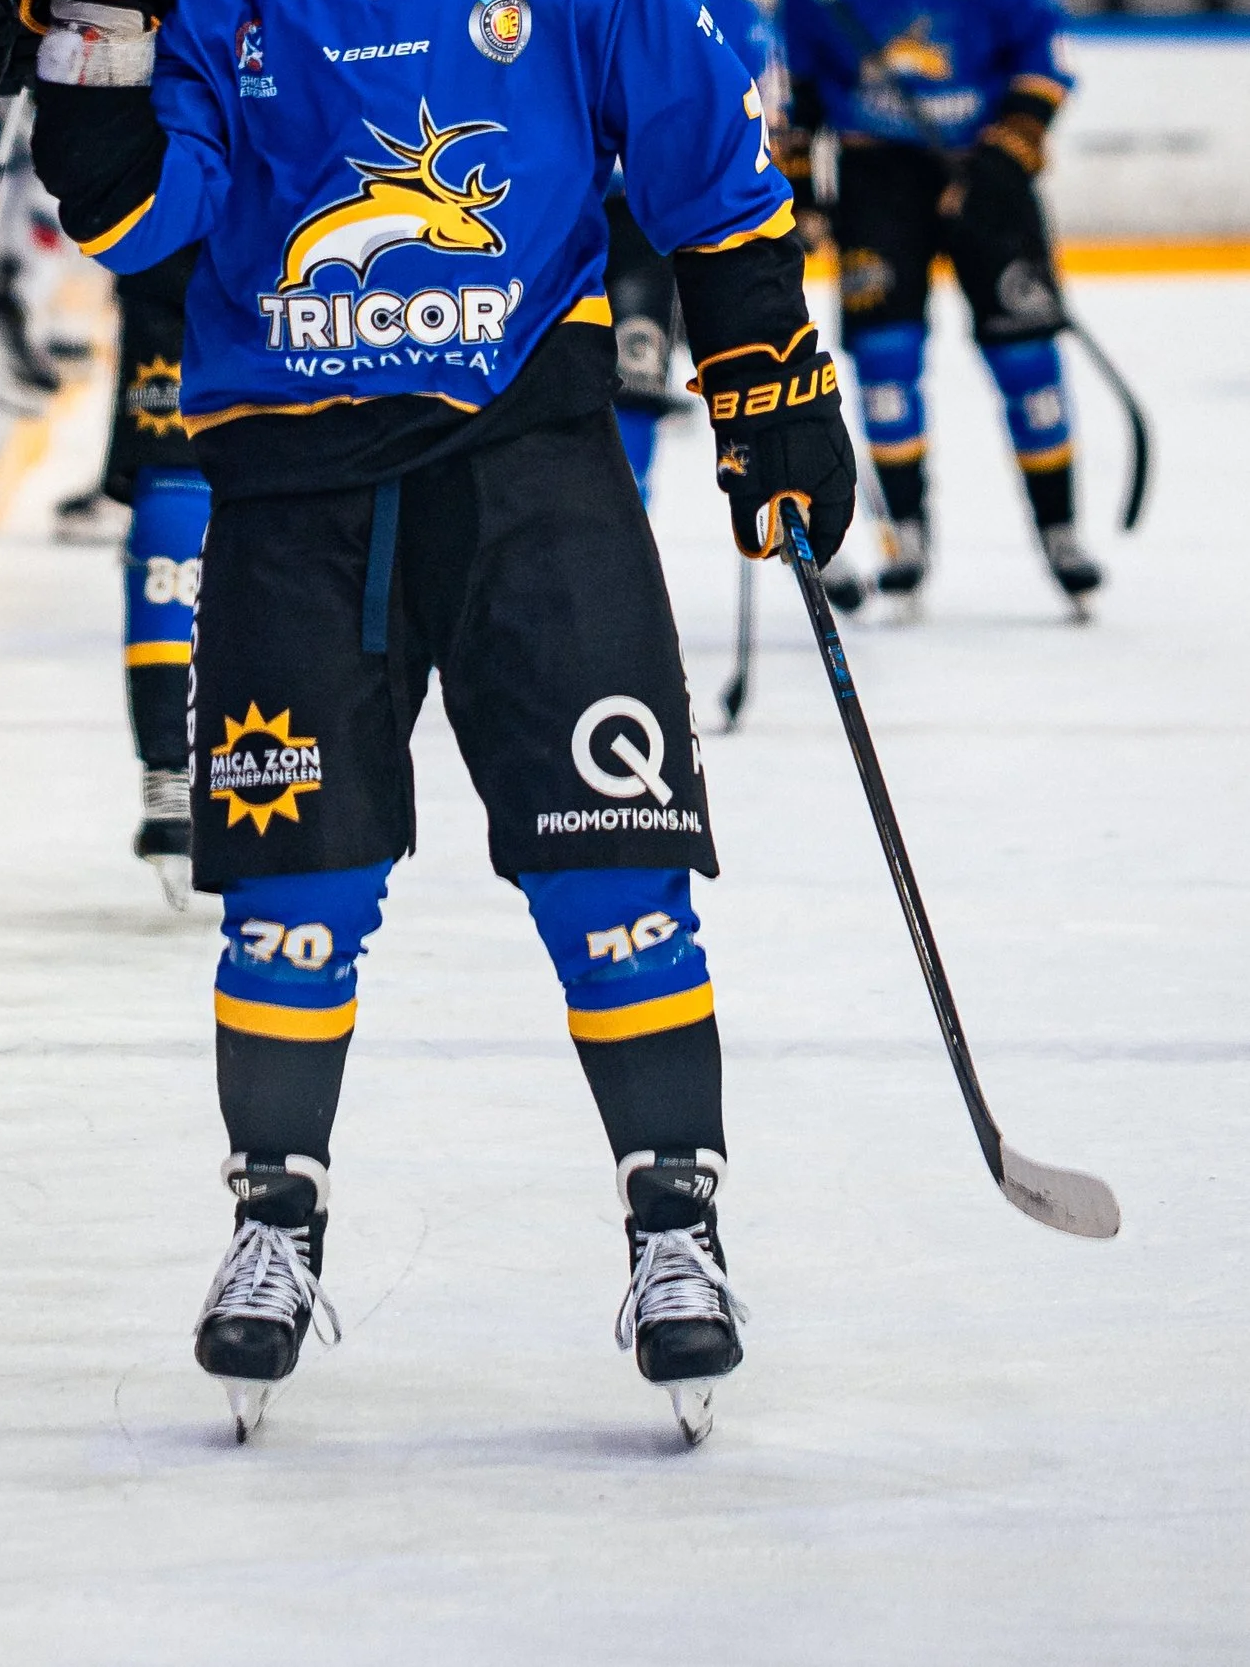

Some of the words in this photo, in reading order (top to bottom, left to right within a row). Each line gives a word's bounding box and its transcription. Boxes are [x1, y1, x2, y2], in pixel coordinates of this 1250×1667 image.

[341, 40, 431, 63] BAUER
[257, 278, 524, 352] TRICOR
[145, 556, 202, 607] 88
[210, 750, 260, 776] MICA
[264, 744, 321, 771] ZON
[571, 694, 674, 808] Q
[209, 765, 322, 790] ZONNEPANELEN
[536, 807, 703, 836] PROMOTIONS.NL
[240, 917, 334, 971] 70
[692, 1174, 714, 1199] 70
